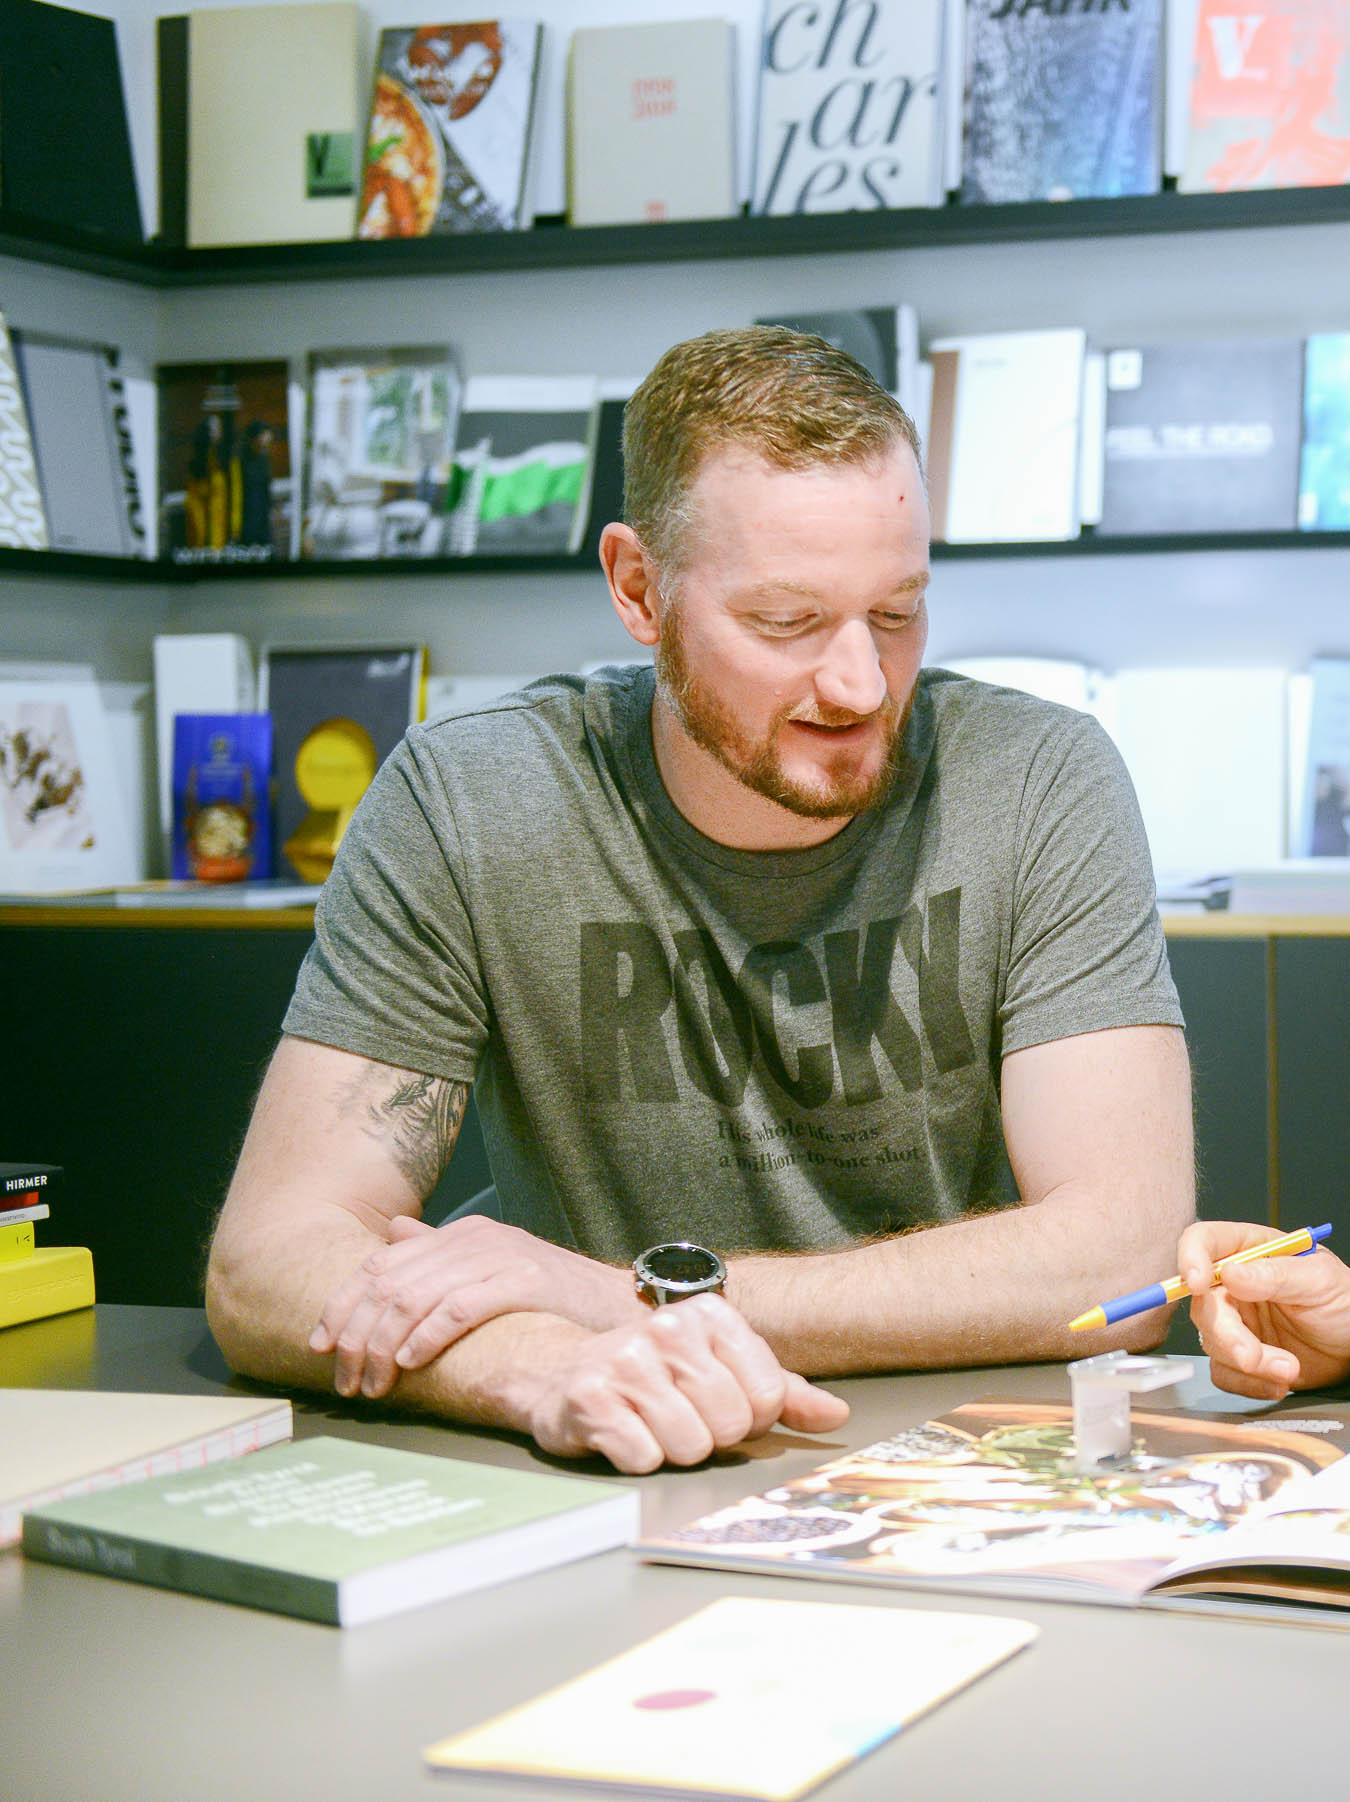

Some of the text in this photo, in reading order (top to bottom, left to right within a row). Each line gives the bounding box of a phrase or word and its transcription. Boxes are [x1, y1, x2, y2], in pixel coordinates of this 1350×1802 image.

[768, 0, 888, 74] ch
[810, 74, 938, 150] ar
[579, 886, 977, 1108] ROCKY
[718, 1117, 881, 1145] His whole life was
[6, 1175, 48, 1192] HIRMER
[719, 1154, 731, 1168] a
